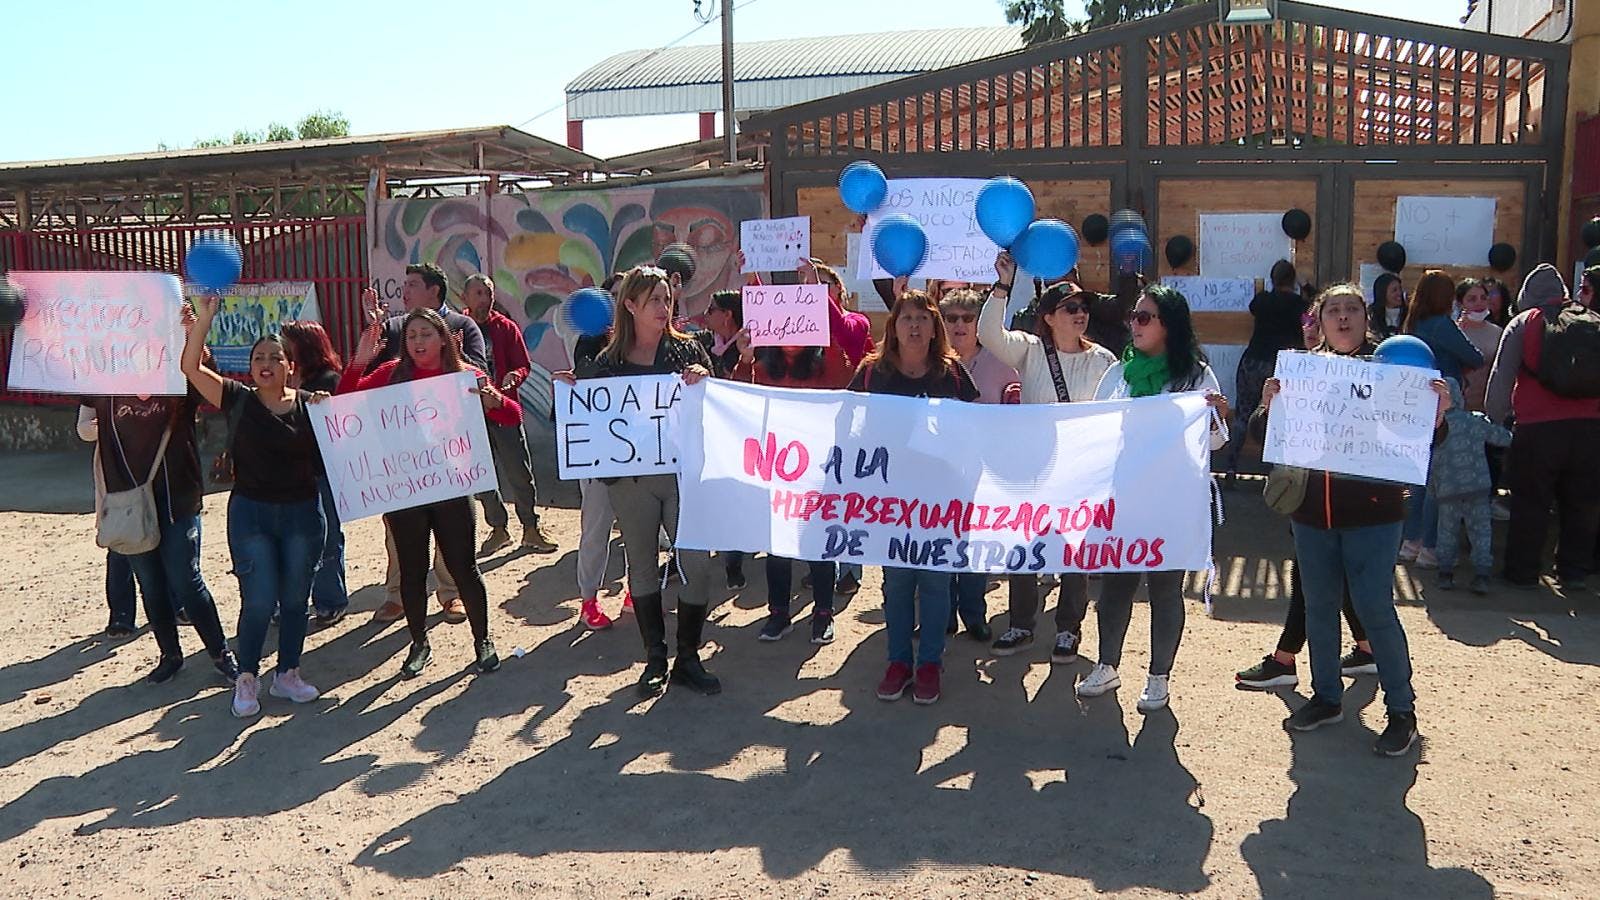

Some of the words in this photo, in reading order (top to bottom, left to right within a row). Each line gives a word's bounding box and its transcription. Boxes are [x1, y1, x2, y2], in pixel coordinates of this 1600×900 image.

[569, 387, 611, 415] NO
[620, 384, 641, 413] A
[655, 382, 682, 410] LA
[1350, 382, 1373, 400] NO
[324, 413, 363, 442] NO
[380, 398, 438, 430] MAS
[743, 432, 810, 482] NO
[821, 445, 843, 484] A
[854, 446, 889, 484] LA
[338, 491, 349, 514] A
[771, 488, 1116, 542] HIPERSEXUALIZACIÓN
[821, 524, 870, 559] DE
[887, 533, 1047, 571] NUESTROS
[1062, 535, 1165, 571] NIÑOS
